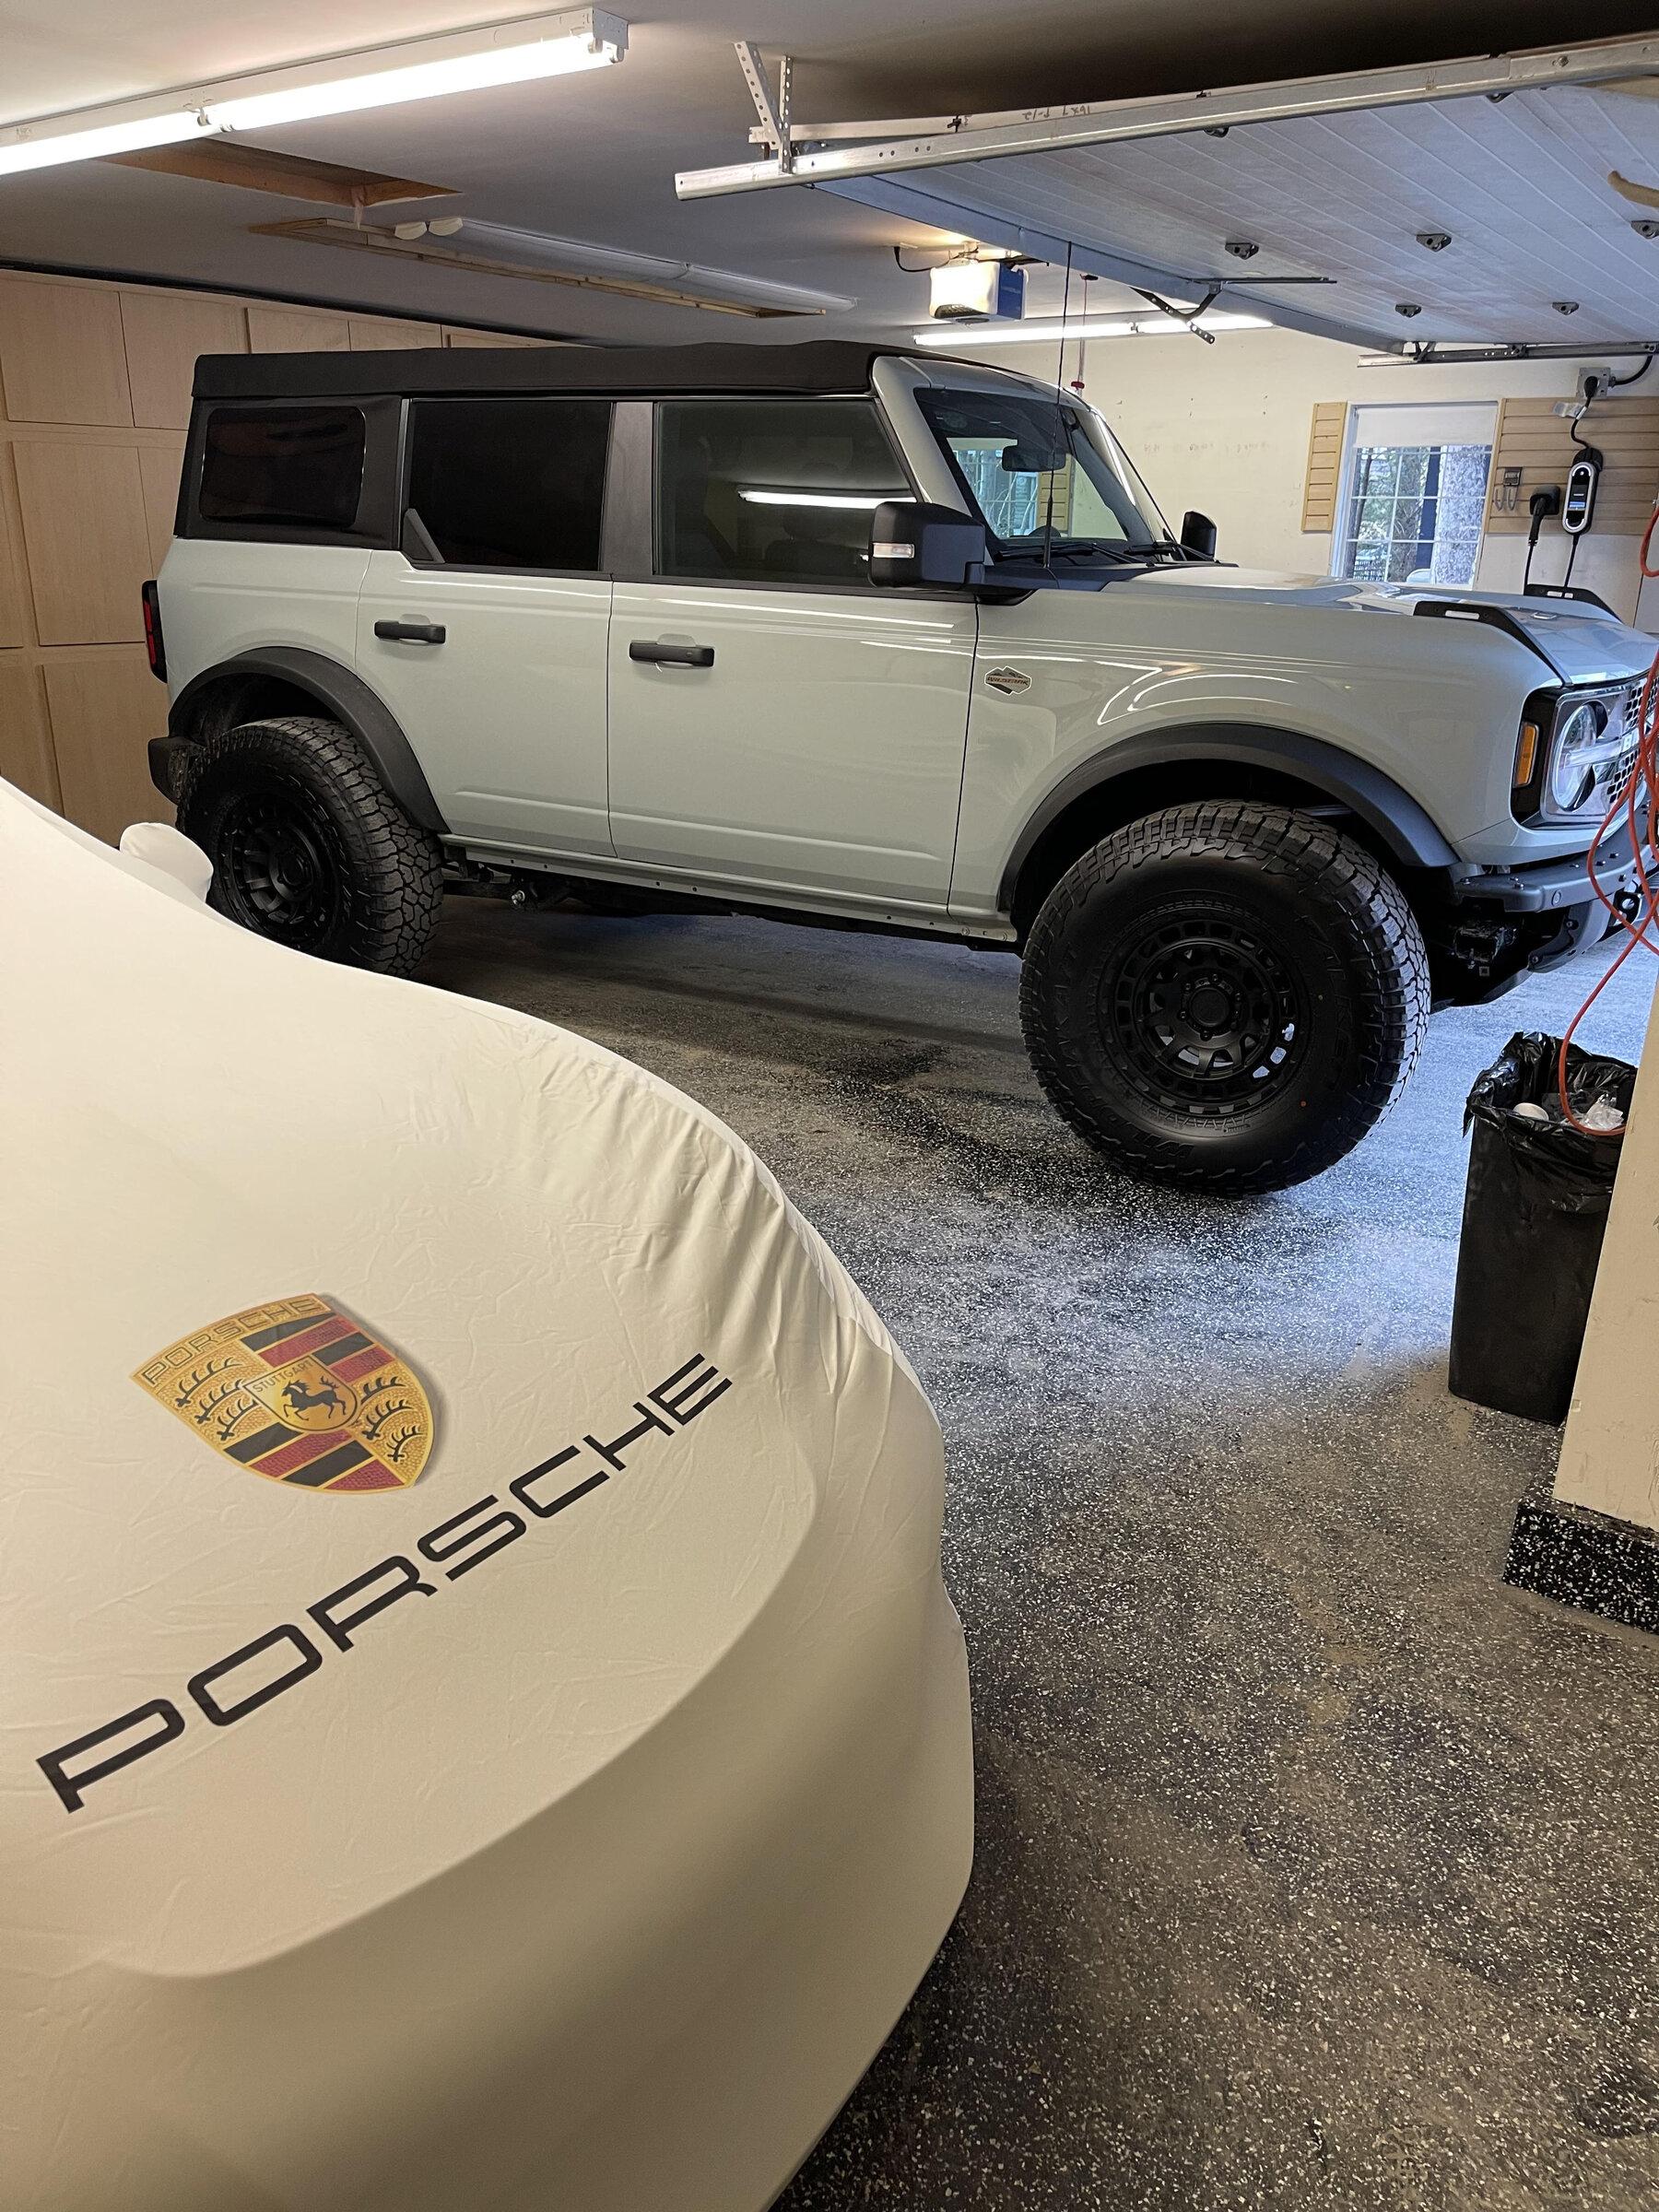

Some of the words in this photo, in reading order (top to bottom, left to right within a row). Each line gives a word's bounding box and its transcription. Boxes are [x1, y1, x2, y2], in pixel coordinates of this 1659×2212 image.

[142, 1298, 324, 1386] PORSCHE
[254, 1359, 315, 1393] STUTTGART
[36, 1353, 734, 1815] PORSCHE
